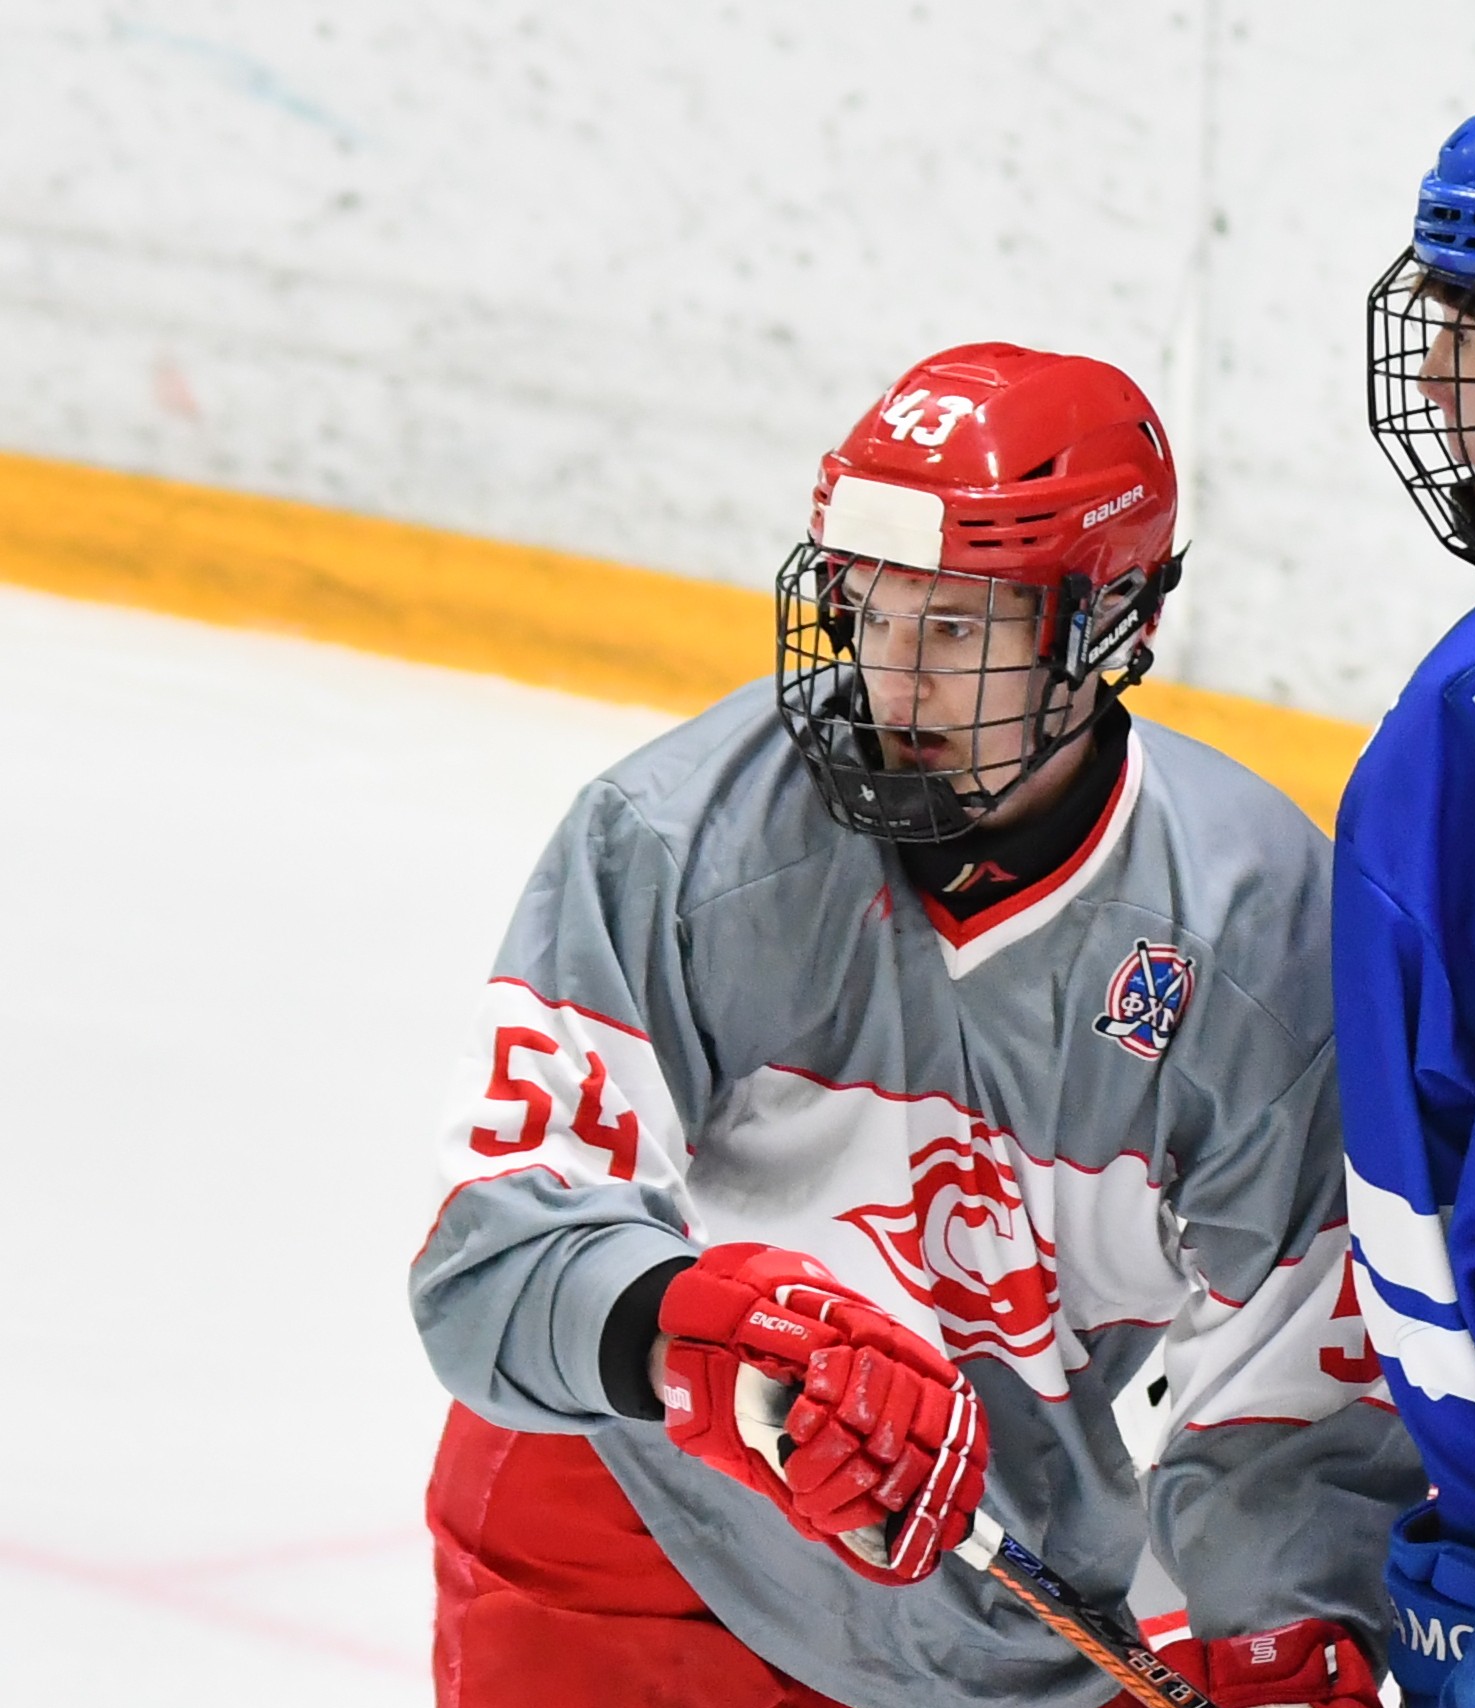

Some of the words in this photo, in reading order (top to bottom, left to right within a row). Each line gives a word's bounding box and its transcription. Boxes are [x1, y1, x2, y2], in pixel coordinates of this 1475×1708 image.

[883, 388, 973, 447] 43
[1082, 484, 1145, 529] BAUER
[1088, 609, 1139, 665] BAUER
[469, 1026, 639, 1182] 54
